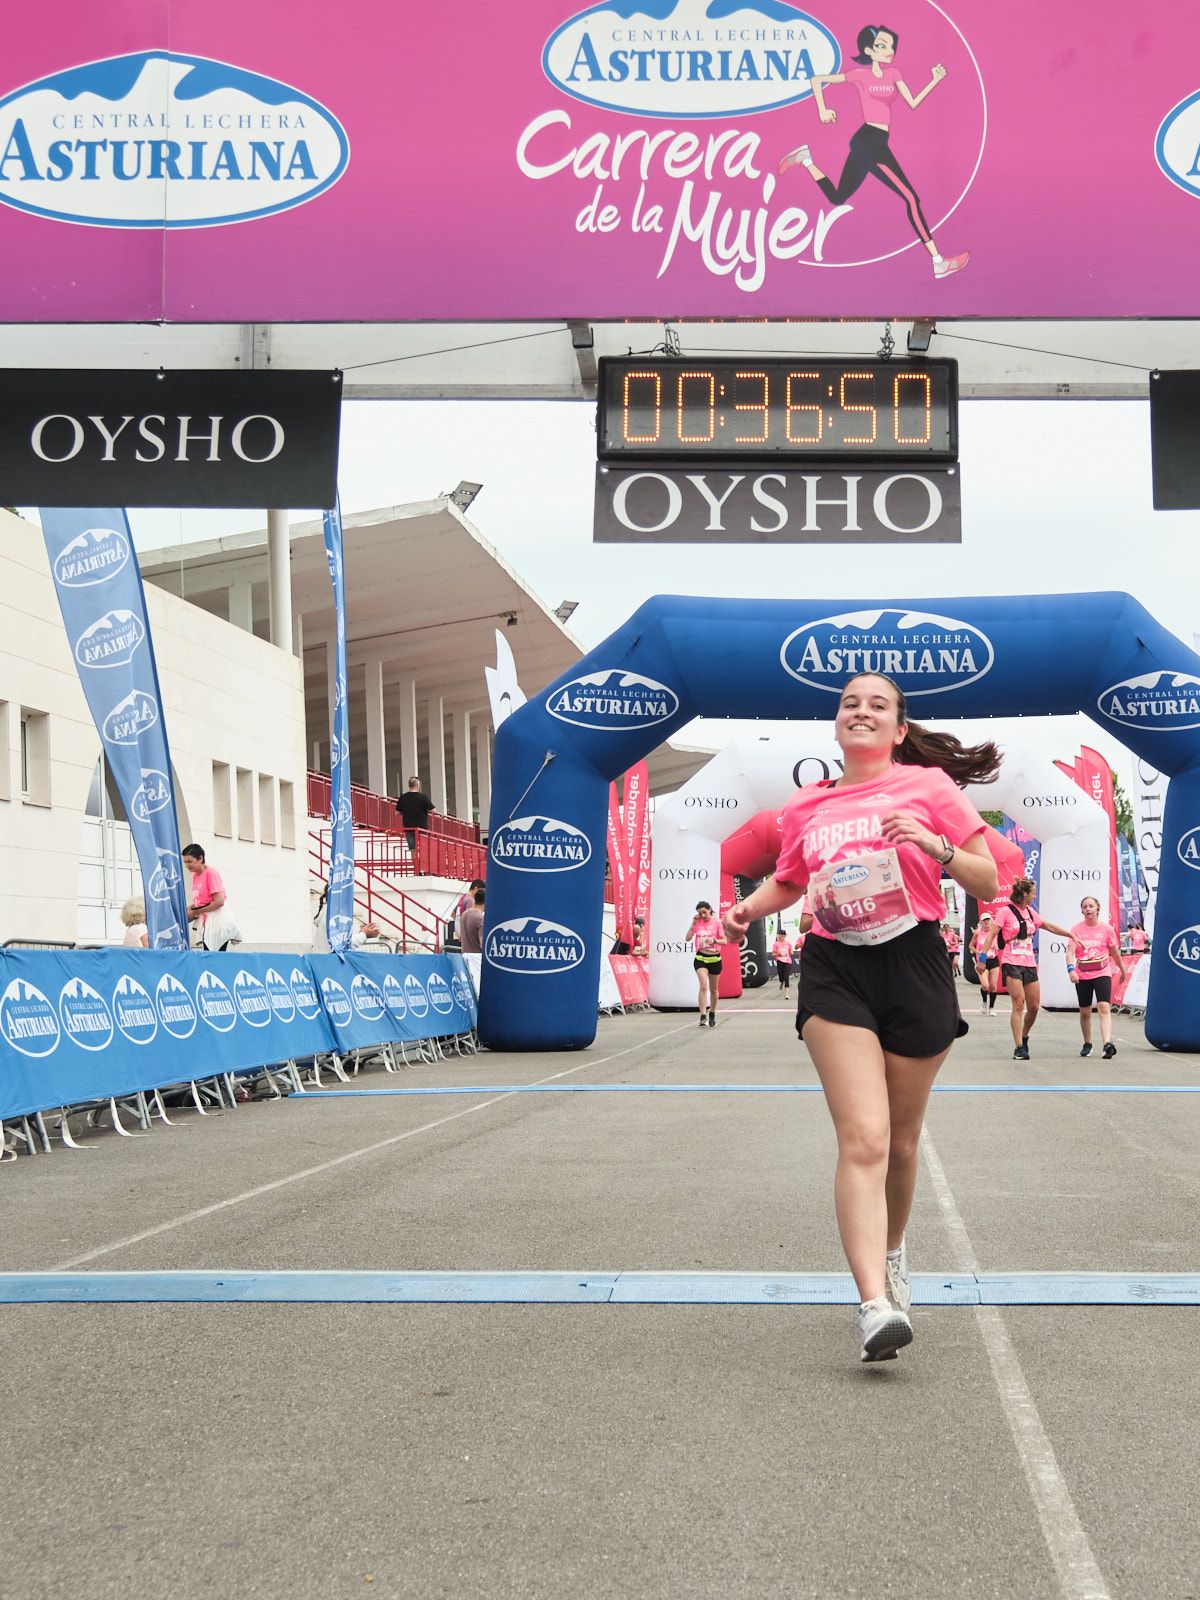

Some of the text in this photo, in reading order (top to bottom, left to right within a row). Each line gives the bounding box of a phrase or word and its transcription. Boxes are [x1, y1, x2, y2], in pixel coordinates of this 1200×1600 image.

[612, 29, 809, 42] CENTRAL LECHERA
[565, 32, 816, 83] ASTURIANA
[52, 113, 306, 130] CENTRAL LECHERA
[0, 117, 318, 182] ASTURIANA
[516, 109, 761, 181] Carrera
[575, 173, 854, 292] de la Mujer
[623, 372, 931, 445] 00:36:50
[30, 414, 285, 464] OYSHO
[613, 473, 943, 533] OYSHO
[830, 635, 971, 644] CENTRAL LECHERA
[796, 636, 979, 674] ASTURIANA
[553, 691, 668, 716] ASTURIANA
[622, 690, 666, 699] LECHERA
[1127, 691, 1172, 699] CENTRAL
[684, 797, 738, 809] OYSHO
[1023, 796, 1077, 807] OYSHO
[495, 836, 584, 861] ASTURIANA
[803, 814, 883, 860] CARRERA
[659, 868, 709, 881] OYSHO
[1052, 869, 1102, 881] OYSHO
[841, 897, 876, 917] 016
[489, 936, 578, 961] ASTURIANA
[657, 942, 694, 953] OYSH
[6, 1009, 58, 1040] ASTURIANA
[65, 1004, 112, 1033] ASTURIANA
